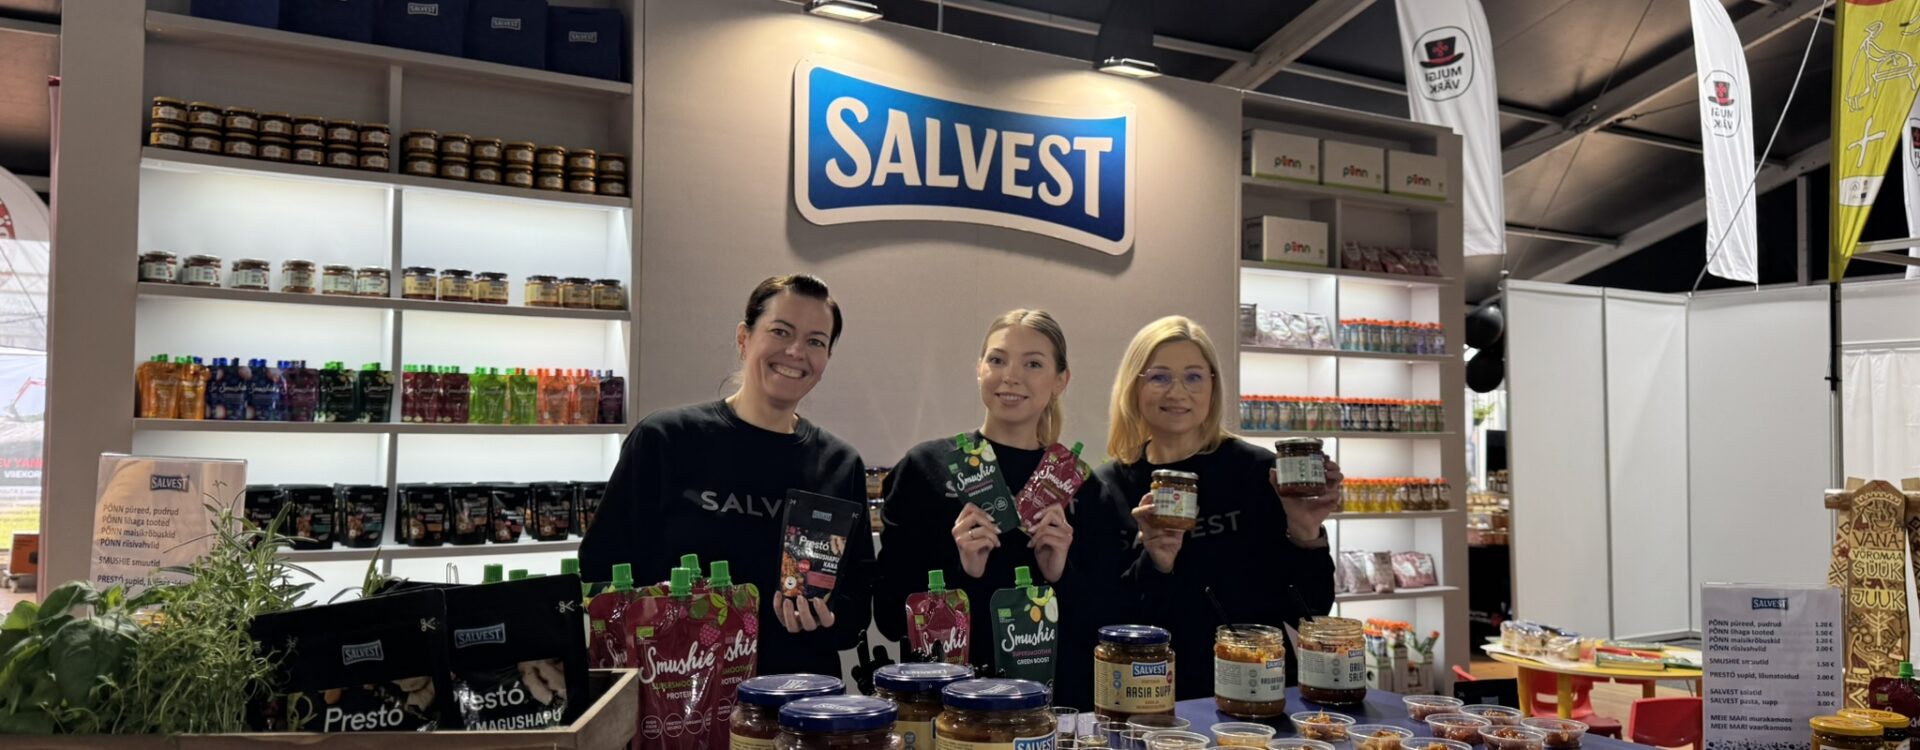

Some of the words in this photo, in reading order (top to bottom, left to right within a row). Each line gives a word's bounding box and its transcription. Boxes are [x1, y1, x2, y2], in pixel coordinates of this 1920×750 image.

[825, 96, 1113, 218] SALVEST
[151, 477, 188, 490] SALVEST
[957, 462, 995, 491] Smushie
[701, 491, 783, 519] SALV
[102, 514, 122, 524] PÕNN
[146, 517, 169, 526] tooted
[1853, 560, 1904, 581] SÜÜK
[1754, 599, 1786, 608] SALVEST
[457, 630, 501, 645] SALVEST
[1001, 620, 1055, 652] Smushie
[345, 647, 379, 661] SALVEST
[638, 641, 716, 684] Smushie
[1133, 663, 1165, 676] SALVEST
[456, 681, 525, 713] restó
[1126, 687, 1152, 698] AASIA
[324, 701, 403, 733] Prestó
[476, 707, 562, 731] MAGUSHAPU
